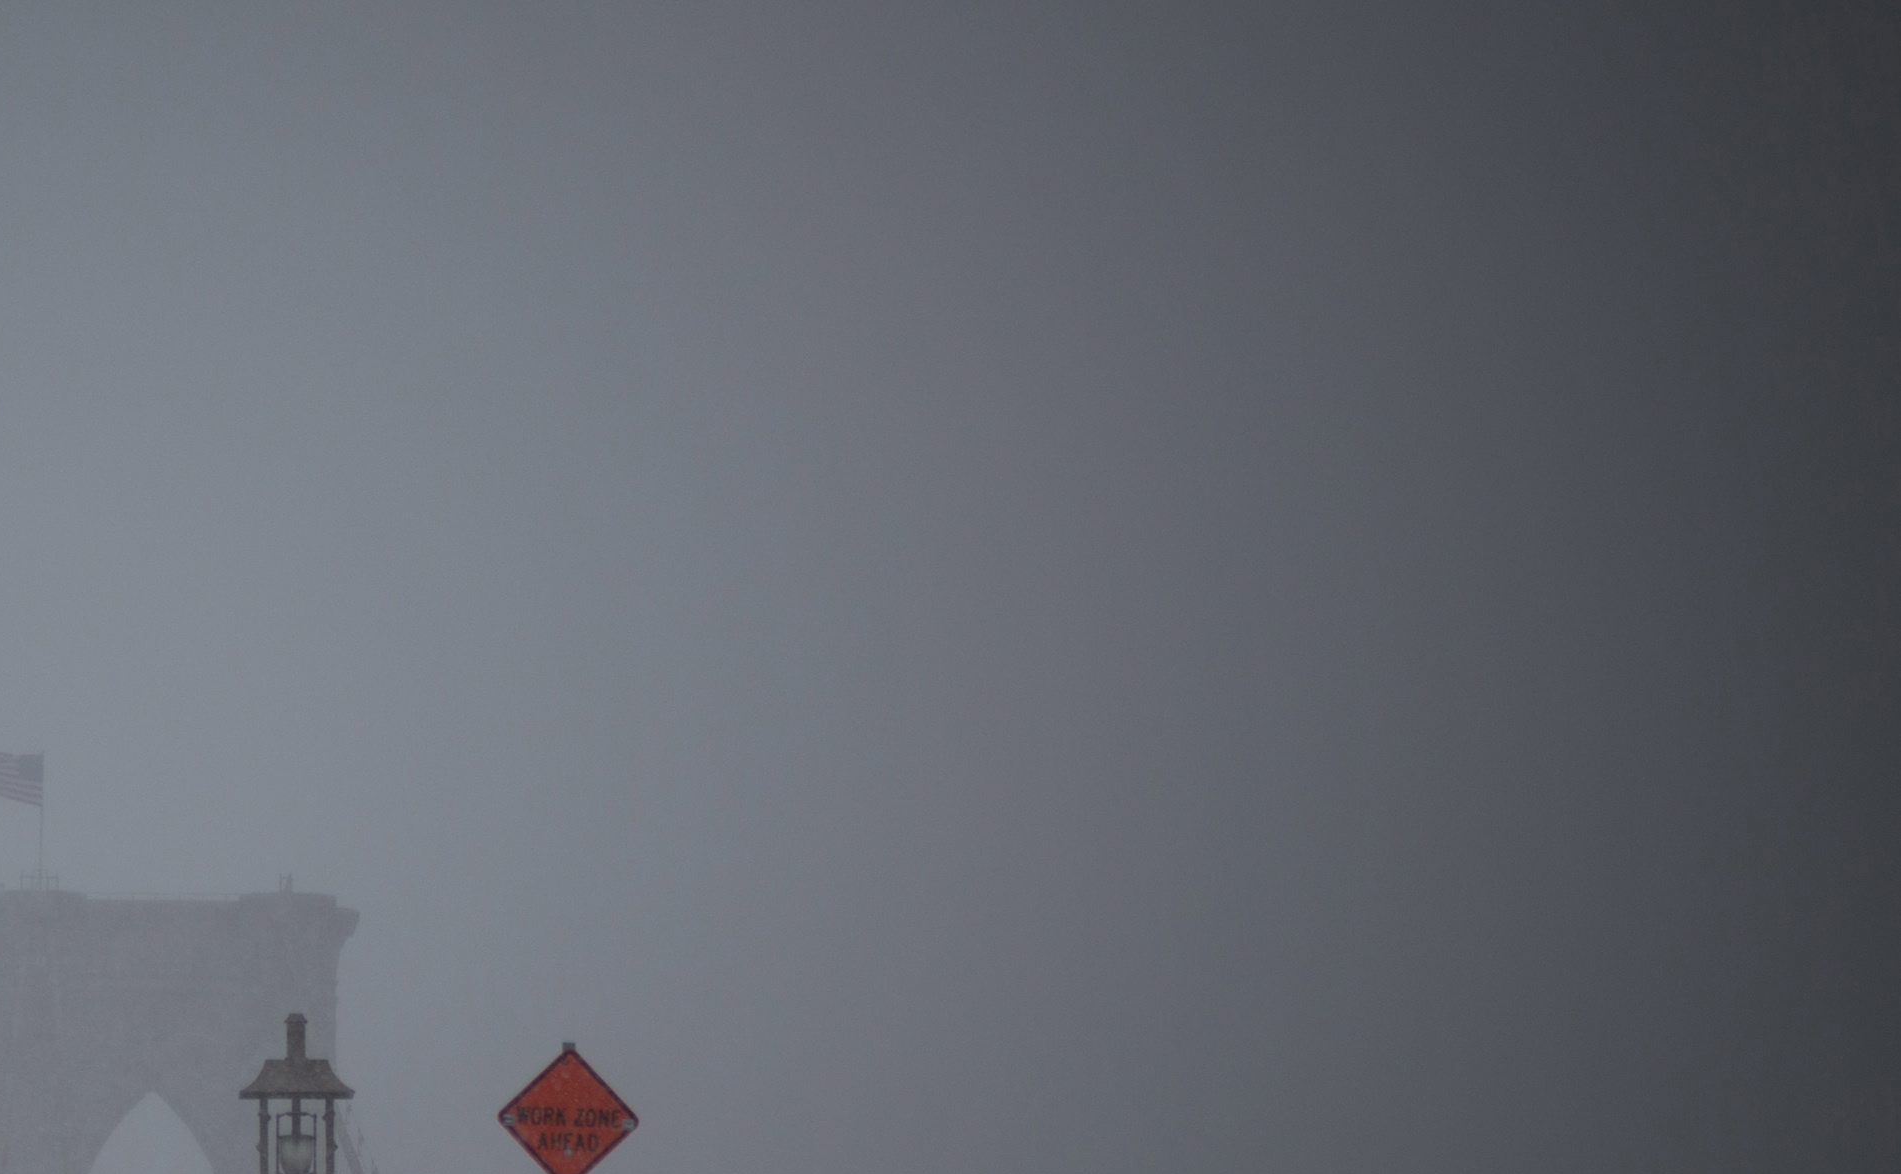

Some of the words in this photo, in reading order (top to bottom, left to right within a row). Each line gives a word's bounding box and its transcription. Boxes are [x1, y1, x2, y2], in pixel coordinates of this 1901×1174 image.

[517, 1106, 567, 1126] WORK
[574, 1108, 622, 1129] ZONE
[538, 1133, 599, 1153] AHEAD
